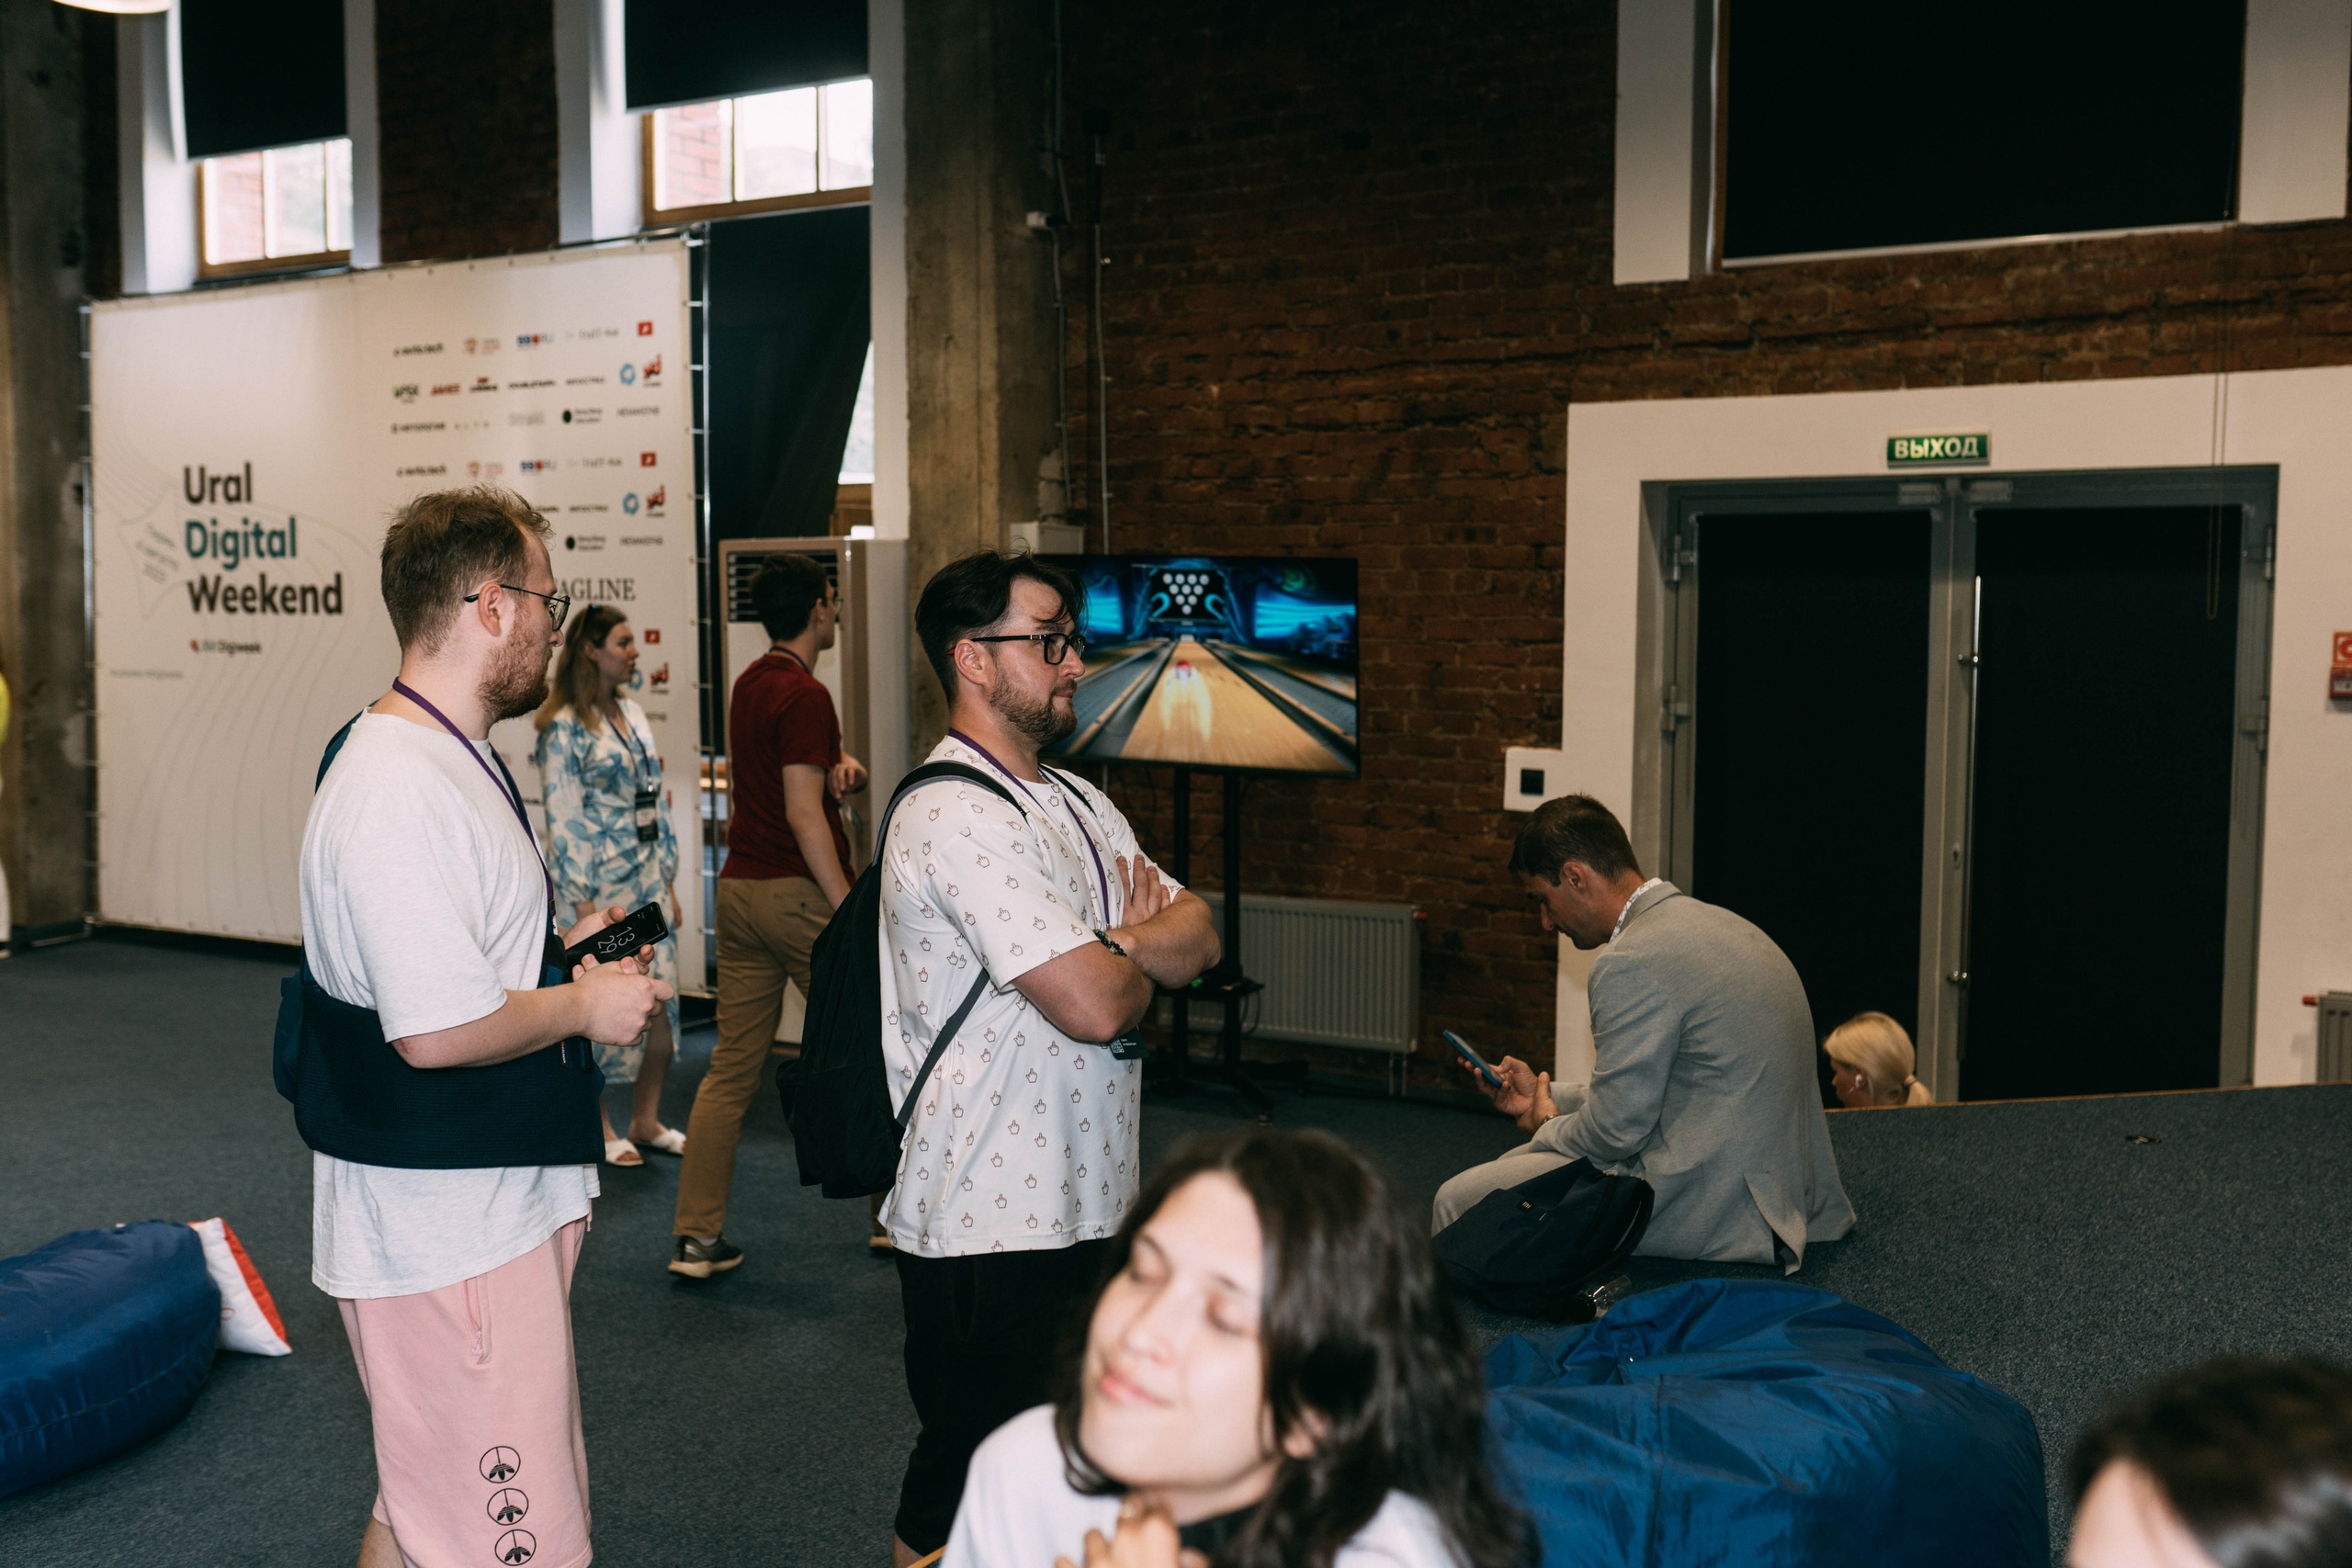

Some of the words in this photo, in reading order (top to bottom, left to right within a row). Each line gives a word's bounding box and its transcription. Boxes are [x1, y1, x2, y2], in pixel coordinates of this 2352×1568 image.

[1894, 436, 1978, 458] ВЫХОД
[184, 461, 253, 504] Ural
[186, 515, 297, 570] Digital
[187, 571, 344, 615] Weekend
[554, 577, 636, 601] AGLINE
[597, 935, 617, 953] 29
[616, 926, 635, 946] 13
